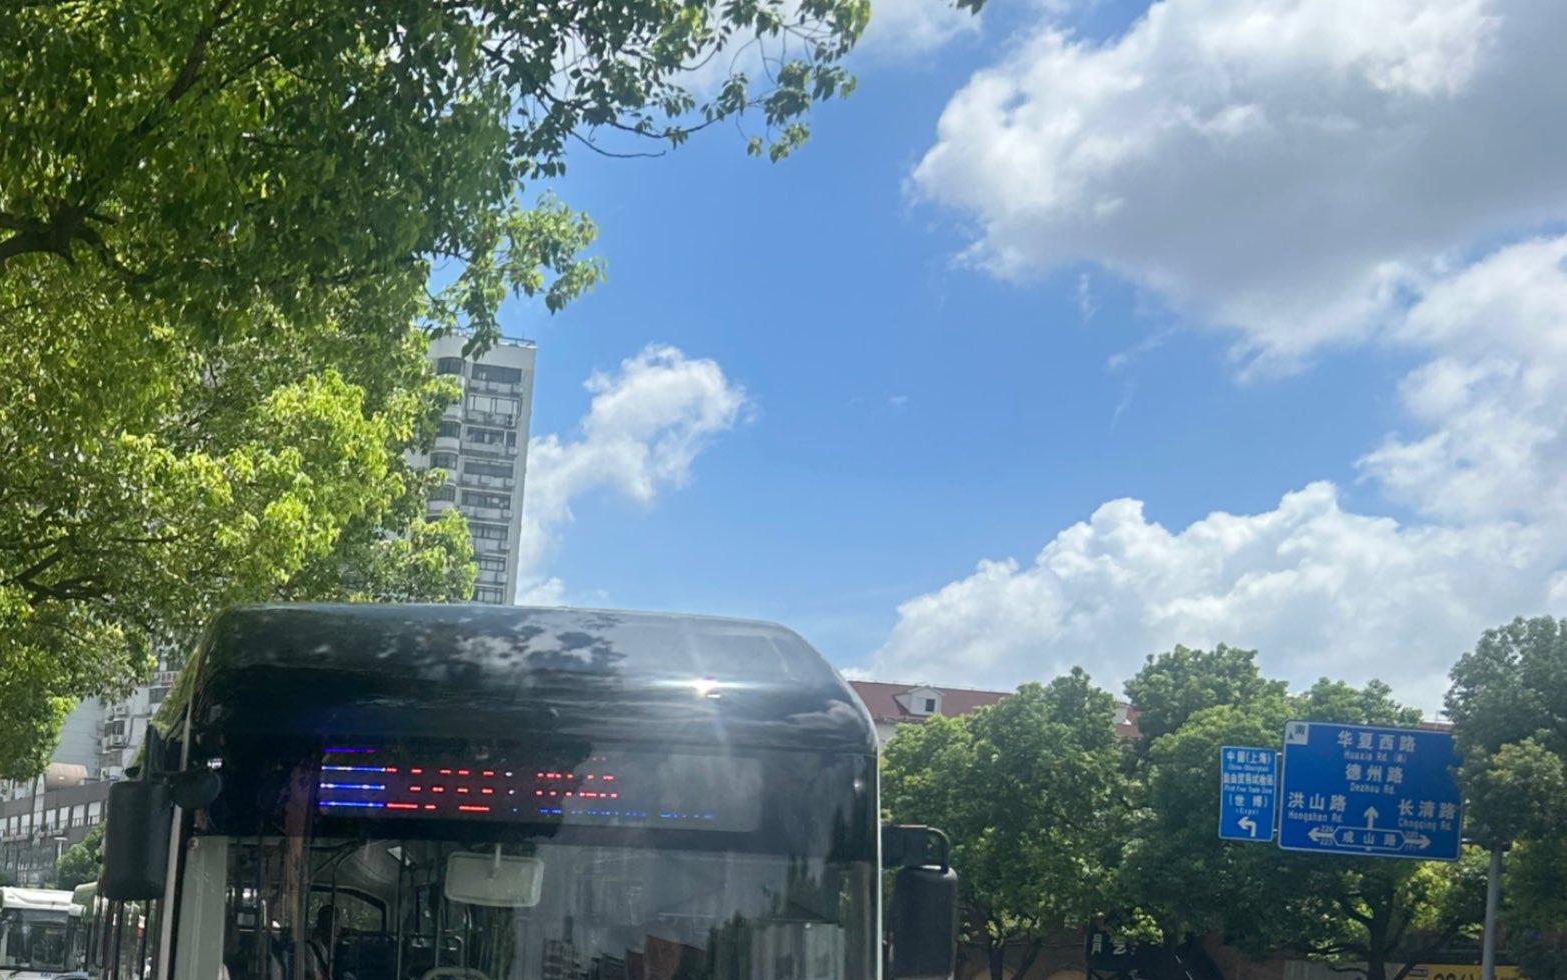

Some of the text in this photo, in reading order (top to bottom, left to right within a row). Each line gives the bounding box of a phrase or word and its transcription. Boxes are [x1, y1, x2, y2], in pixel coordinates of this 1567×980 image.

[1337, 730, 1416, 752] 华夏西路
[1345, 763, 1404, 784] 德州路
[1287, 792, 1347, 812] 洪山路
[1398, 799, 1456, 820] 长清路
